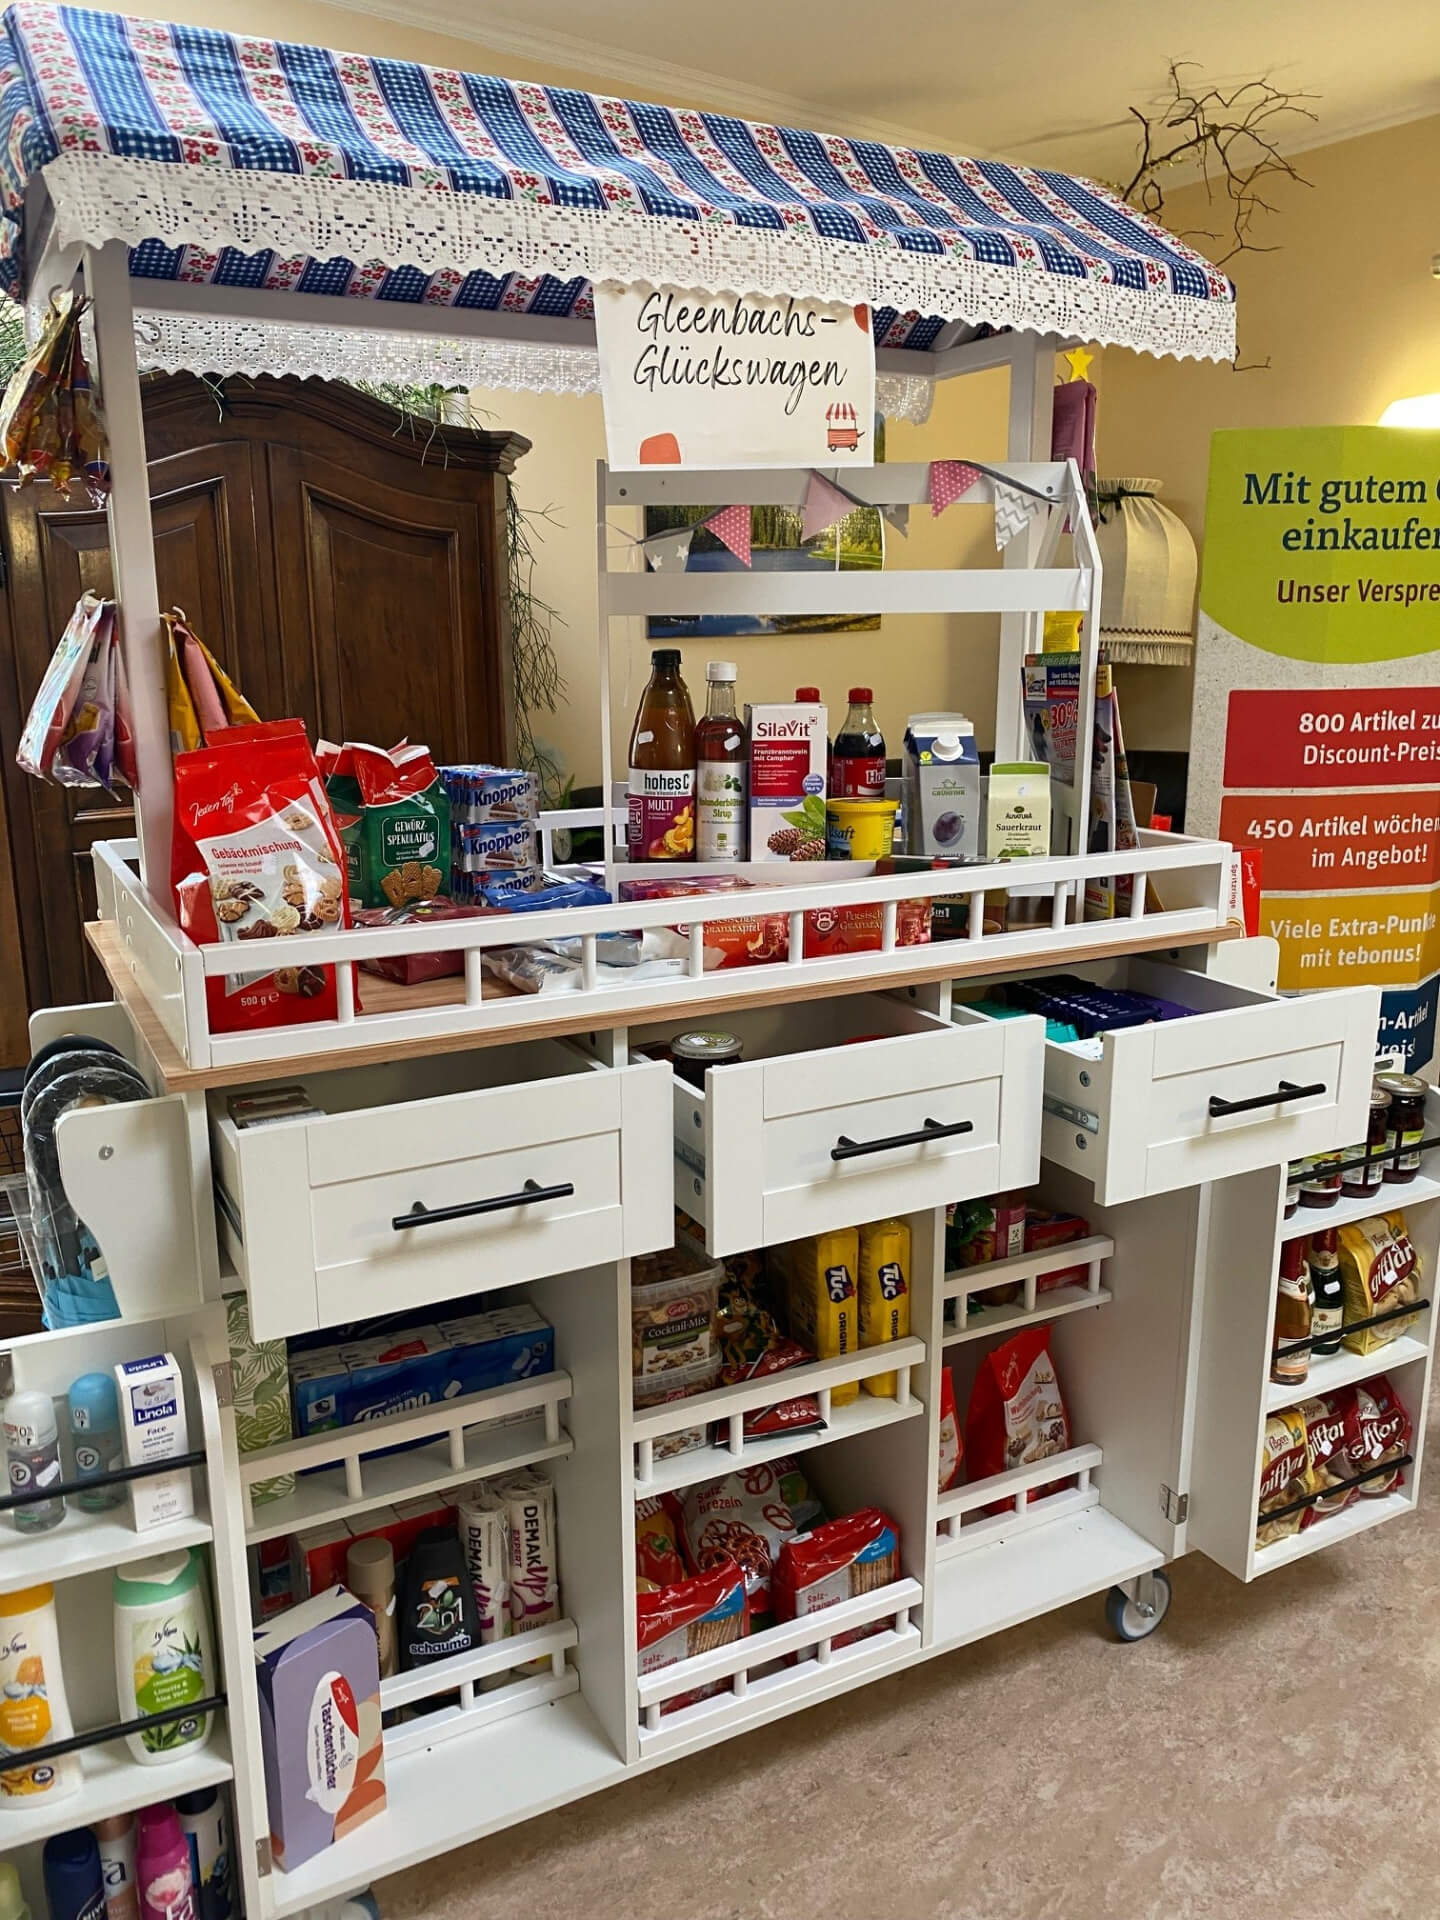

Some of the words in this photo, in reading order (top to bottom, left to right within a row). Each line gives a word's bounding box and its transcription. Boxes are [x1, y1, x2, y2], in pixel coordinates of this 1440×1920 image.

[637, 291, 838, 340] Gleenbachs-
[633, 344, 848, 415] Glückswagen
[1242, 471, 1311, 505] Mit
[1318, 475, 1427, 514] gutem
[1277, 579, 1350, 603] Unser
[756, 720, 811, 737] SilaVit
[1298, 712, 1345, 734] 800
[1350, 709, 1416, 733] Artikel
[644, 773, 681, 790] hohes
[647, 799, 673, 811] MULTI
[387, 831, 435, 846] SPEKULATIUS
[995, 823, 1042, 832] Sauerkraut
[1247, 819, 1294, 840] 450
[1300, 815, 1367, 838] Artikel
[211, 840, 302, 859] Gebäckmischung
[1310, 848, 1335, 868] im
[1341, 844, 1428, 870] Angebot!
[1229, 863, 1239, 909] Spritzringe
[1270, 917, 1322, 939] Viele
[1300, 948, 1332, 969] mit
[1338, 944, 1421, 967] tebonus!
[240, 996, 258, 1007] 500
[830, 1266, 848, 1300] TUC
[883, 1263, 900, 1299] TUC
[137, 1404, 173, 1422] Linola
[409, 1634, 471, 1655] schauma
